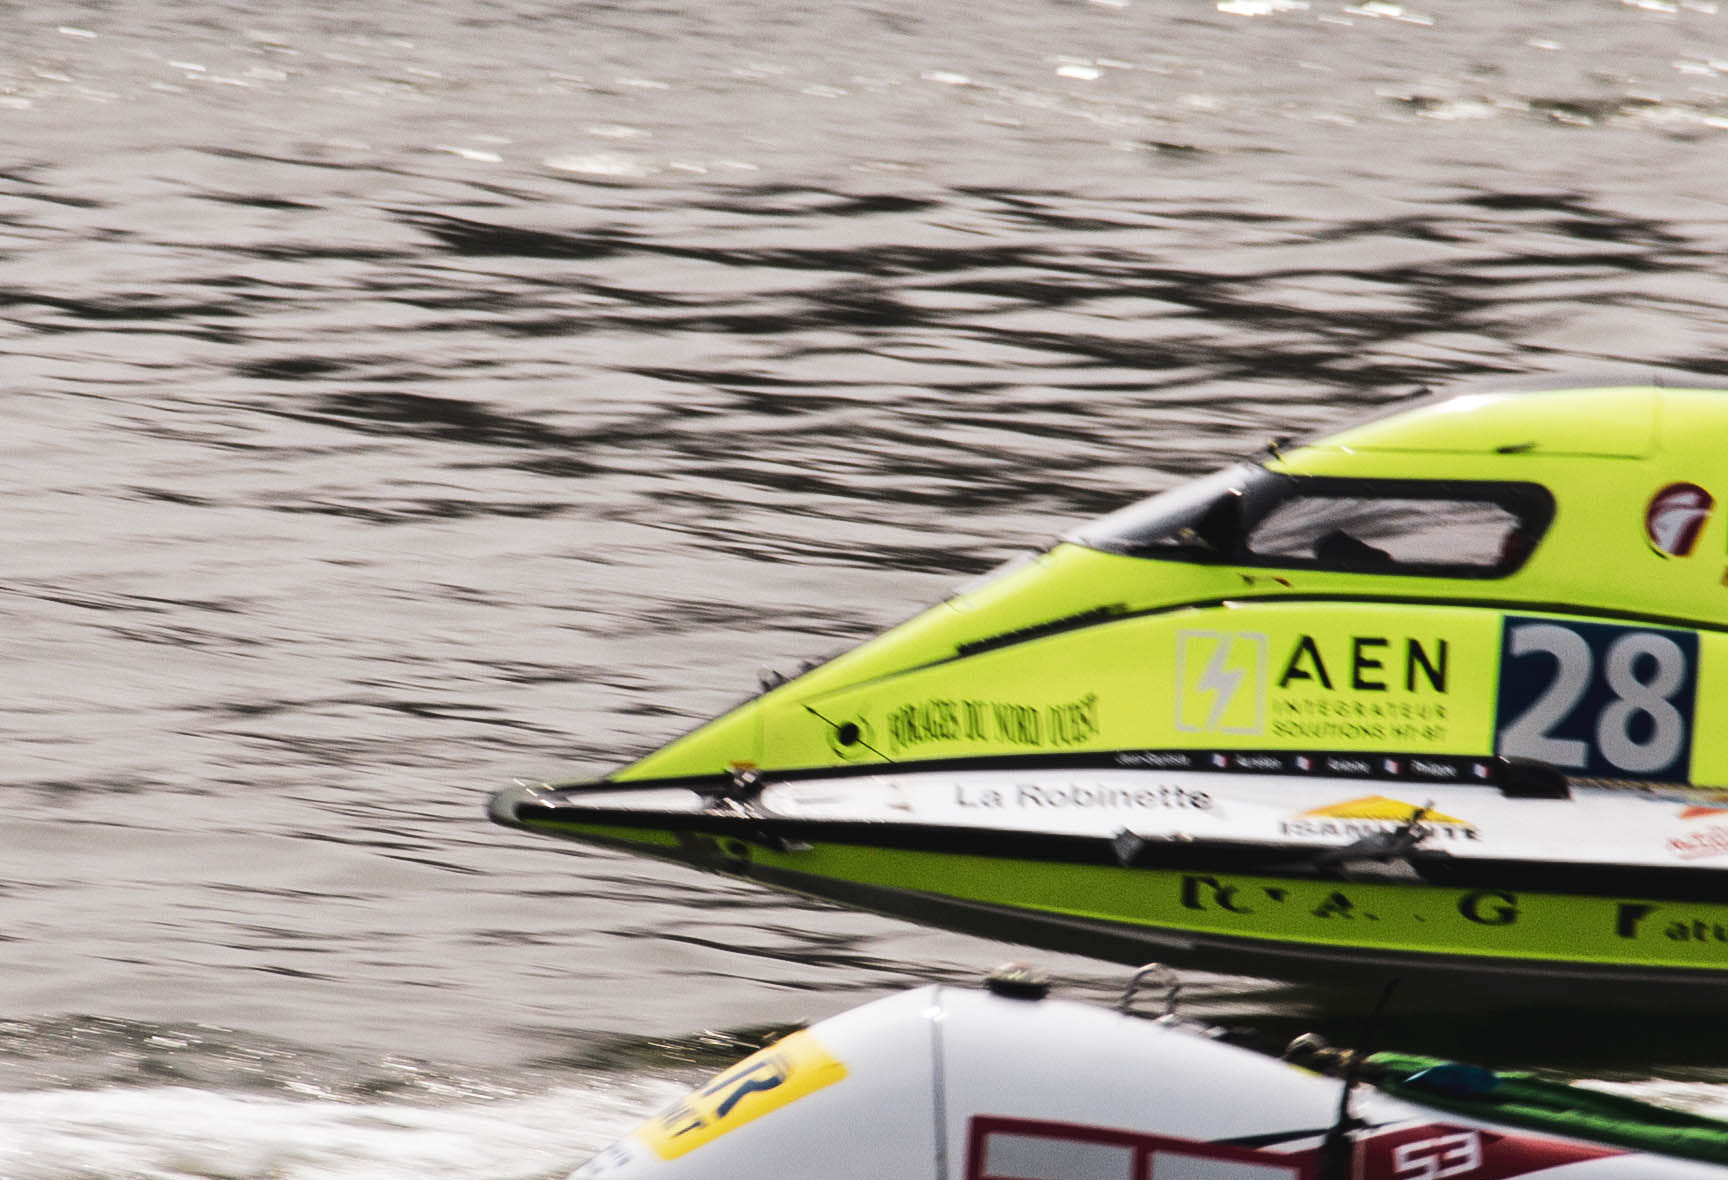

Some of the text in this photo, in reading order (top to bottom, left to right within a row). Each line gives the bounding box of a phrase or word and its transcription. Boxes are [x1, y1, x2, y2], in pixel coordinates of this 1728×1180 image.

[1277, 634, 1449, 693] AEN
[1500, 623, 1689, 773] 28
[956, 783, 1212, 810] La Robinette
